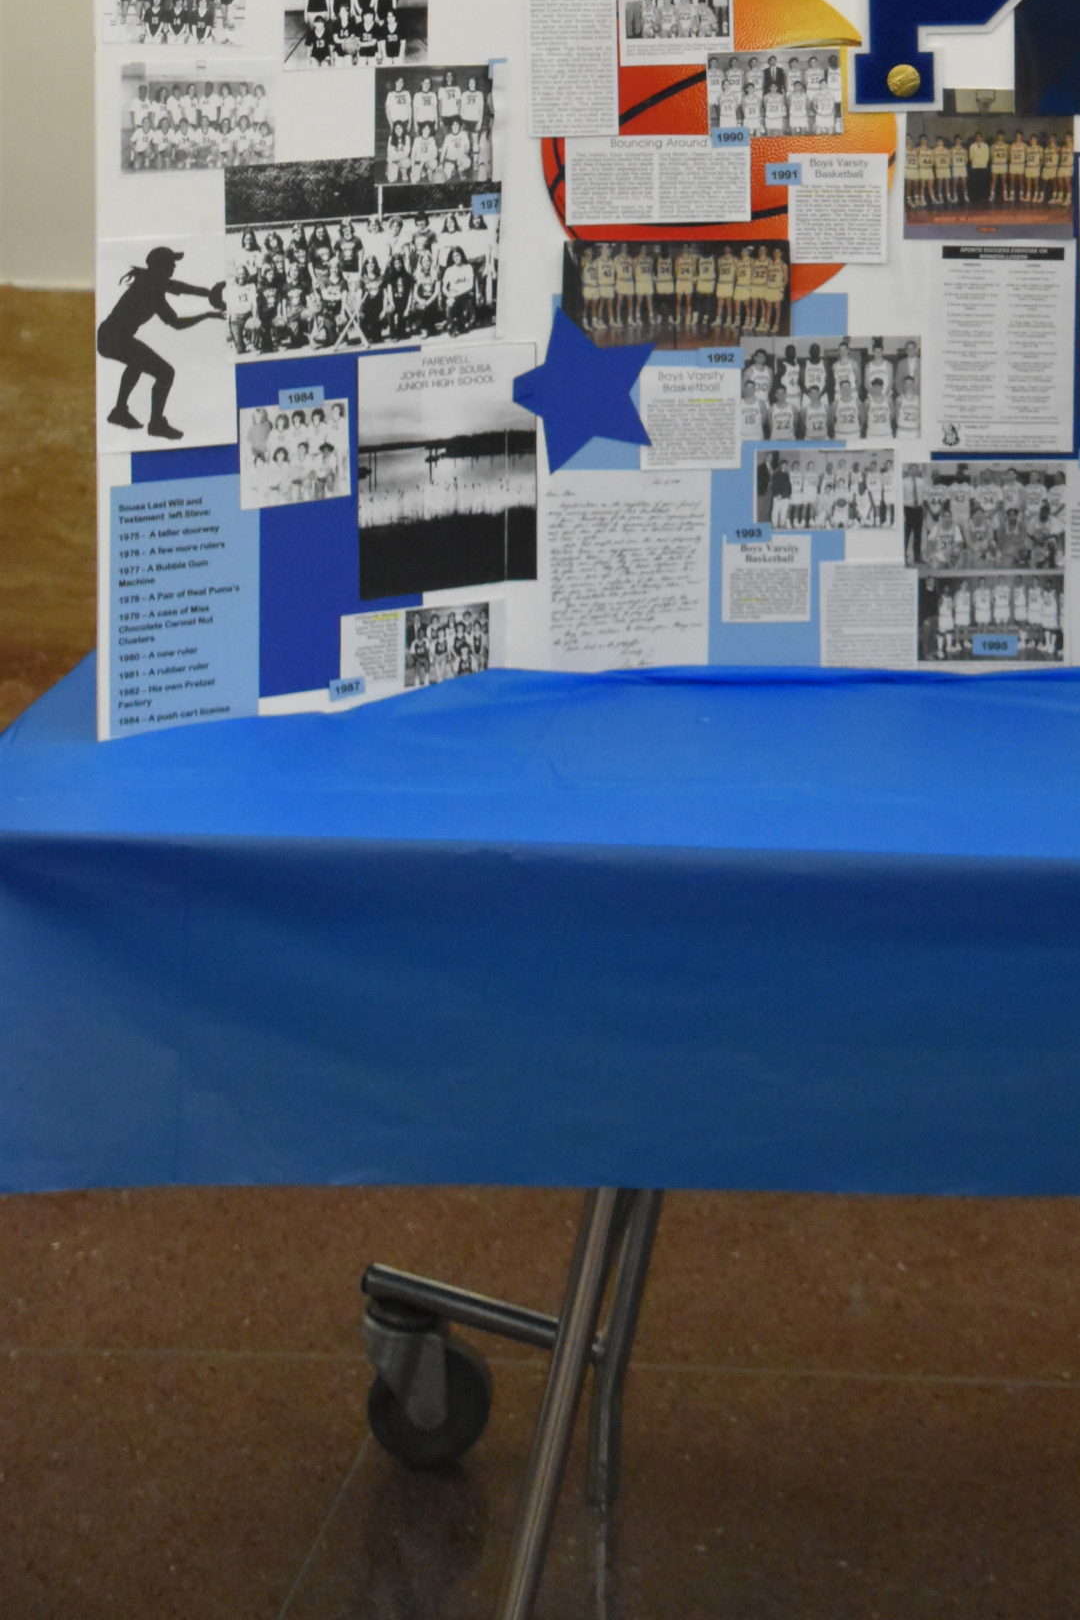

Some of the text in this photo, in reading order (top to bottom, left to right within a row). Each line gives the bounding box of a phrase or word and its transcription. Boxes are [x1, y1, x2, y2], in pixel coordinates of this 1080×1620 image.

[610, 137, 708, 150] Bouncing Around
[717, 132, 744, 143] 1990
[809, 157, 870, 169] Boys Varsity
[770, 170, 798, 180] 1991
[815, 169, 864, 179] Basketball
[480, 198, 499, 210] 197
[422, 355, 470, 366] FAREWELL
[707, 353, 735, 363] 1992
[401, 364, 492, 380] JOHN PHILIP SOUSA
[658, 371, 725, 382] Boys Varsity
[396, 375, 495, 392] JUNIOR HIGH SCHOOL
[663, 383, 720, 393] Basketball
[286, 391, 314, 404] 1984
[119, 497, 202, 512] Sousa Last Will and
[119, 513, 164, 524] Testament
[169, 510, 182, 519] left
[119, 525, 219, 541] 1975 A taller doorway
[735, 528, 762, 538] 1993
[149, 547, 156, 556] A
[158, 546, 173, 554] few
[176, 544, 198, 552] more
[200, 541, 225, 550] rulers
[767, 544, 798, 554] Varsity
[745, 554, 794, 563] Basketball
[119, 560, 208, 575] 1977 A Bubble Gum
[119, 577, 155, 588] Machine
[157, 591, 174, 600] Pair
[177, 589, 186, 597] of
[187, 588, 206, 597] Real
[209, 585, 240, 594] Puma's
[157, 609, 178, 617] case
[180, 606, 189, 615] of
[190, 605, 209, 613] Miss
[119, 623, 162, 633] Chocolate
[198, 616, 213, 624] Nut
[119, 635, 155, 646] Clusters
[119, 652, 140, 662] 1980
[157, 650, 176, 658] new
[177, 647, 198, 656] ruler
[119, 670, 139, 680] 1981
[157, 665, 186, 676] rubber
[189, 662, 209, 671] ruler
[165, 683, 183, 691] own
[185, 678, 215, 688] Pretzel
[335, 681, 360, 695] 1987
[119, 699, 152, 709] Factory
[157, 711, 178, 722] push
[180, 709, 198, 718] cart
[200, 706, 230, 715] license
